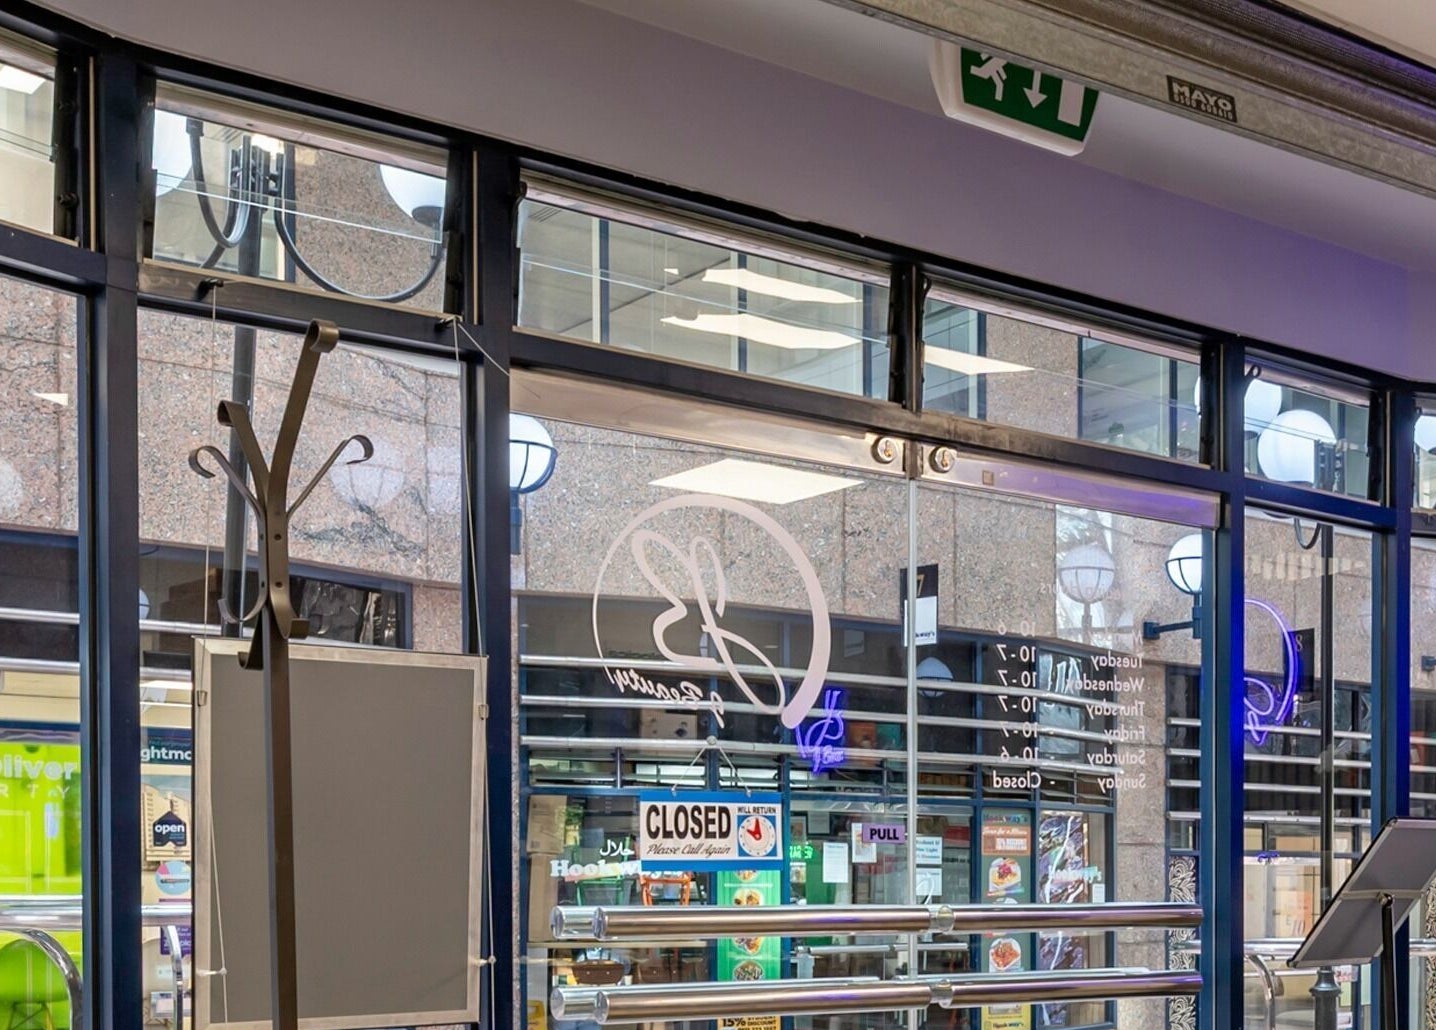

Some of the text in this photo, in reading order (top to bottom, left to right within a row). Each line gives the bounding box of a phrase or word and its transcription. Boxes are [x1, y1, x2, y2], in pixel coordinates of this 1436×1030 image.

[1171, 81, 1233, 111] MAYO
[0, 754, 77, 780] liver
[737, 806, 777, 814] WILL RETURN
[154, 823, 185, 835] open
[645, 804, 732, 840] CLOSED
[869, 827, 899, 841] PULL
[600, 839, 635, 856] حلال
[646, 842, 731, 860] Please Call Again
[722, 1017, 746, 1027] 15%
